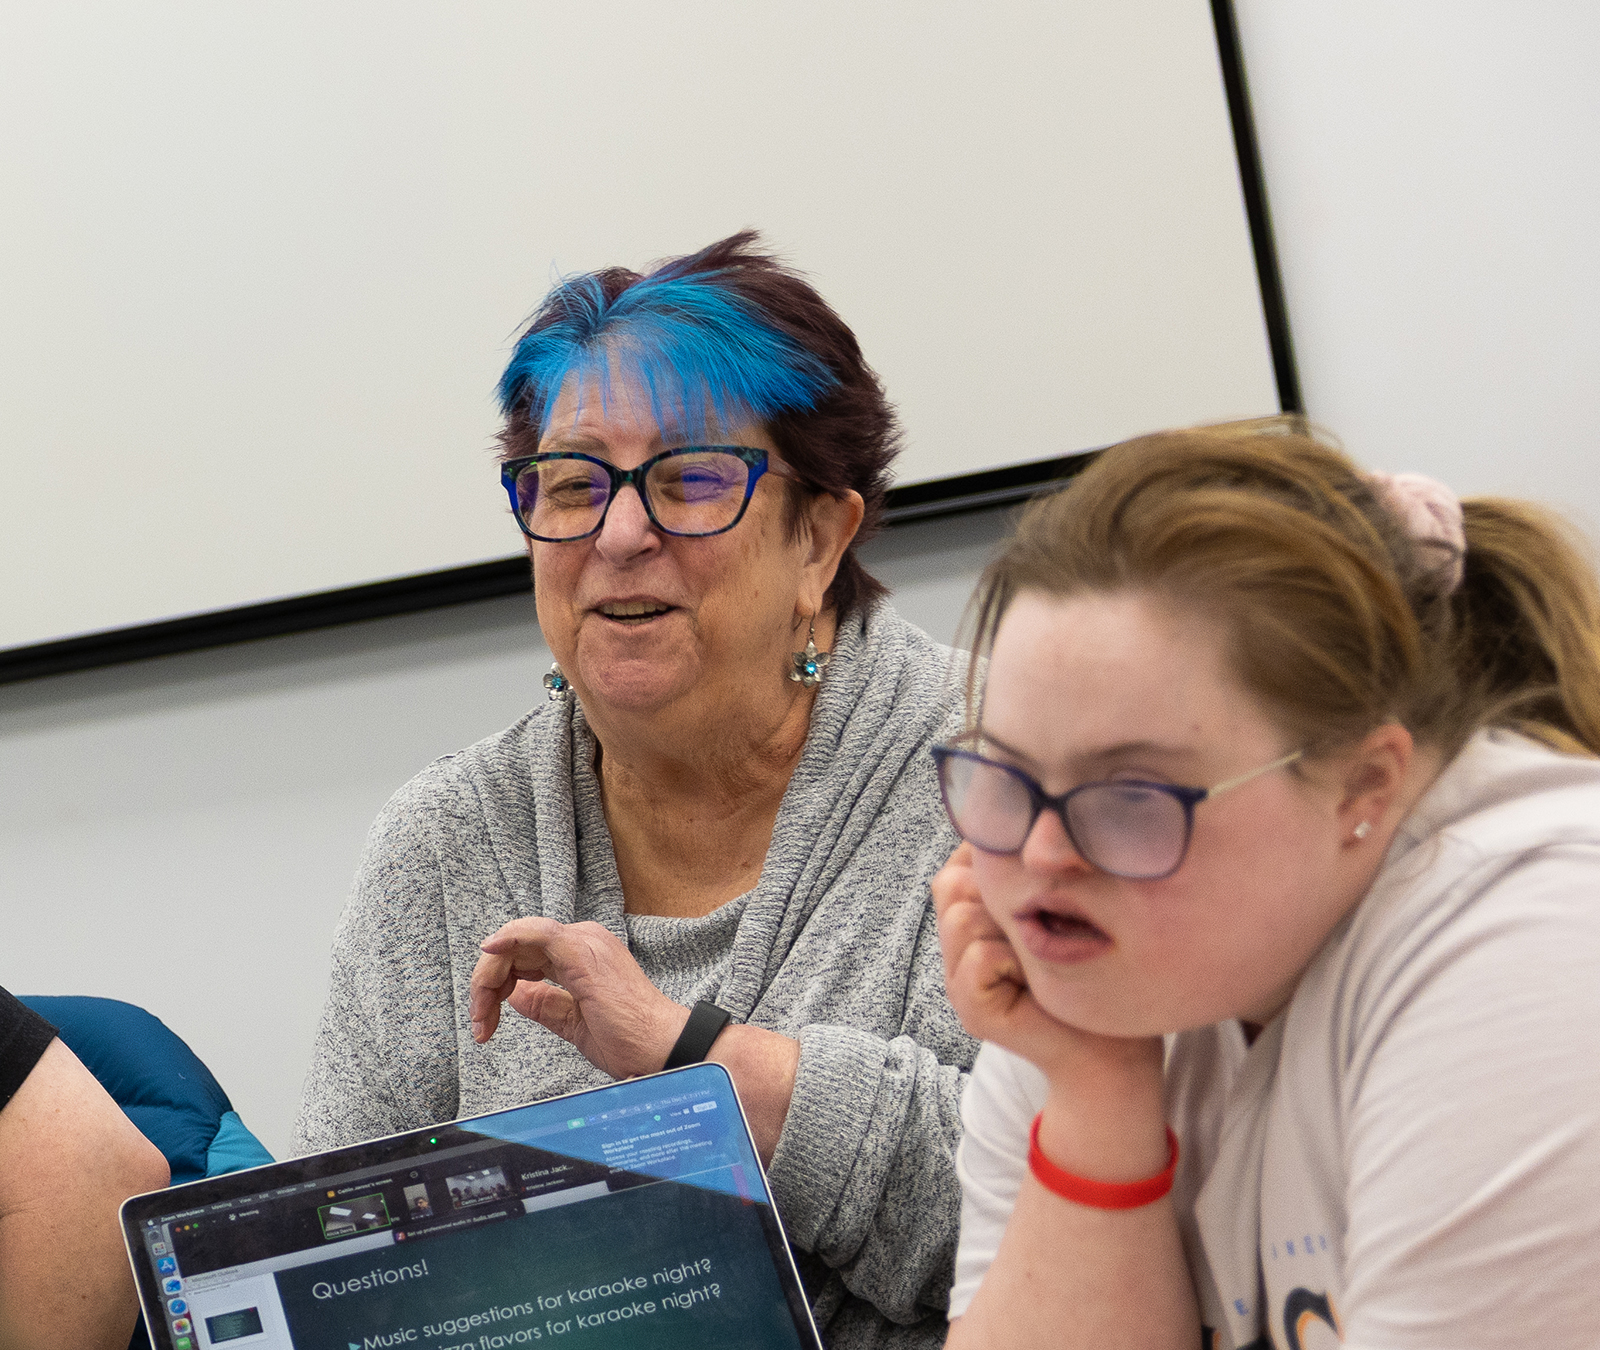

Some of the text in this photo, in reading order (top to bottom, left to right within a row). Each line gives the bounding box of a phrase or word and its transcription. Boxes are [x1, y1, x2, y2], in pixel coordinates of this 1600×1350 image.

[602, 1142, 615, 1150] Sign
[651, 1130, 665, 1138] most
[684, 1122, 700, 1130] Zoom
[604, 1144, 634, 1155] Workplace
[521, 1169, 549, 1180] Kristina
[311, 1259, 429, 1302] Questions!
[423, 1300, 534, 1341] suggestions
[537, 1292, 564, 1312] for
[568, 1273, 648, 1305] karaoke
[652, 1258, 713, 1288] night?
[545, 1317, 572, 1336] for
[577, 1298, 657, 1329] karaoke
[662, 1283, 722, 1312] night?
